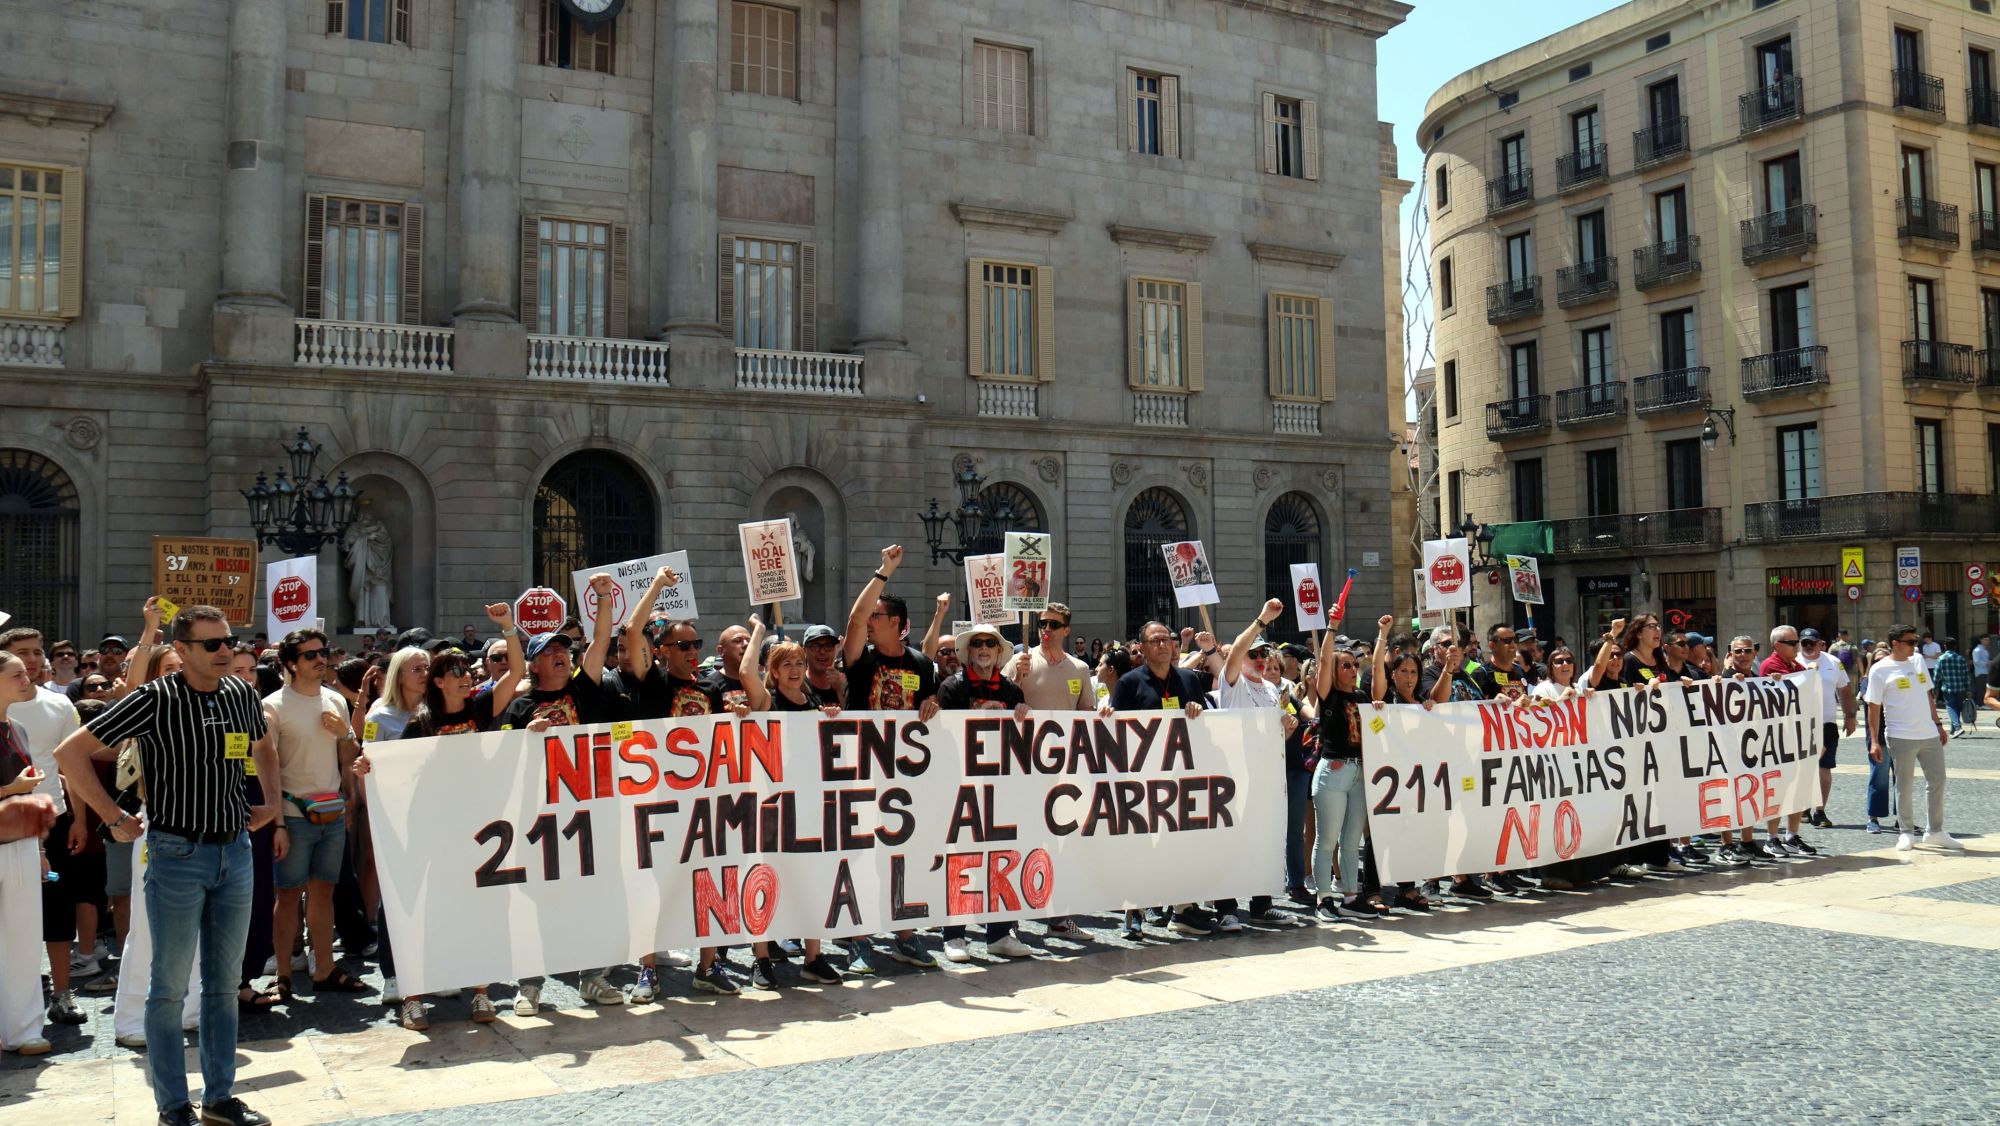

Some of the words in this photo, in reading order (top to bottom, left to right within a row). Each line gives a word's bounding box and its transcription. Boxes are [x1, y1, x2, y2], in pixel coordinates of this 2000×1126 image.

[163, 545, 175, 554] EL
[181, 545, 209, 555] NOSTRE
[213, 546, 228, 557] PARE
[751, 547, 769, 560] NO
[772, 545, 786, 557] AL
[1165, 545, 1175, 555] NO
[166, 555, 188, 571] 37
[188, 561, 206, 571] ANYS
[215, 559, 250, 573] NISSAN
[758, 557, 783, 571] ERE
[1167, 553, 1180, 565] ERE
[1437, 559, 1457, 569] STOP
[618, 561, 648, 578] NISSAN
[756, 570, 778, 579] SOMOS
[1173, 561, 1193, 580] 211
[176, 574, 191, 583] ELL
[196, 574, 207, 583] EN
[228, 576, 240, 585] 57
[975, 577, 992, 589] NO
[1434, 577, 1462, 588] DESPIDOS
[1781, 575, 1834, 592] Alcampo
[167, 587, 179, 595] ON
[197, 588, 205, 596] EL
[211, 588, 234, 597] FUTUR
[278, 580, 302, 594] STOP
[980, 587, 1003, 598] ERE
[1302, 582, 1315, 591] STOP
[171, 597, 187, 605] QUE
[526, 596, 553, 606] STOP
[275, 603, 307, 616] DESPIDOS
[521, 619, 560, 629] DESPIDOS
[1608, 689, 1667, 740] NOS
[1681, 679, 1802, 727] ENGAÑA
[818, 718, 931, 781] ENS
[965, 716, 1195, 777] ENGANYA
[1371, 761, 1452, 815] 211
[1643, 741, 1659, 786] A
[1679, 731, 1728, 778] LA
[1740, 717, 1818, 769] CALLE
[1495, 799, 1582, 866] NO
[1615, 791, 1666, 846] AL
[1698, 769, 1782, 829] ERE
[473, 810, 595, 888] 211
[945, 784, 1017, 844] AL
[1044, 775, 1236, 838] CARRER
[692, 862, 781, 938] NO
[824, 858, 863, 929] A
[891, 847, 1054, 921] L'ERO
